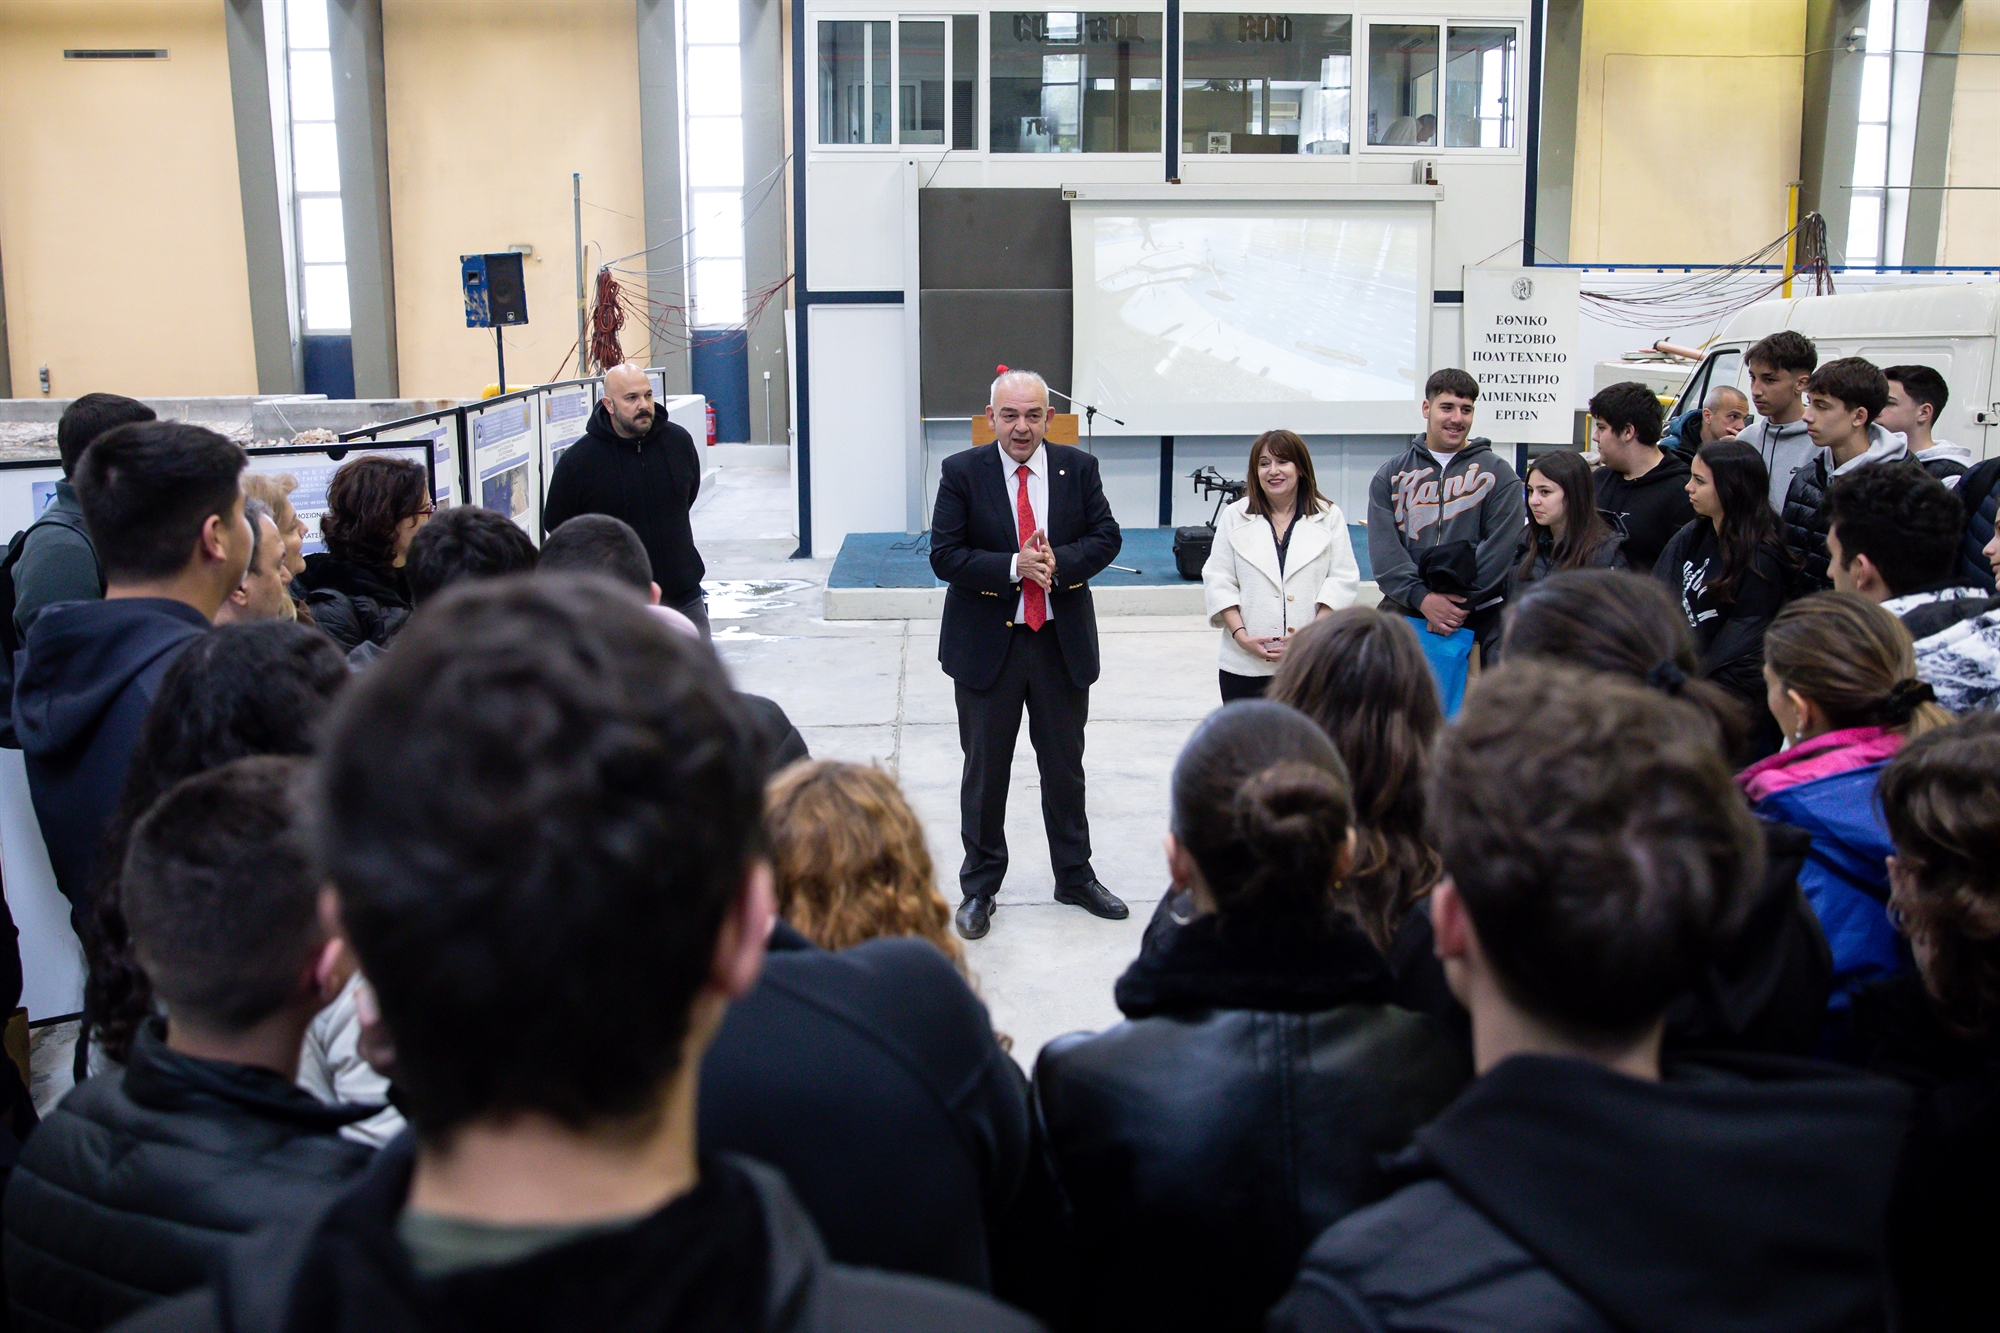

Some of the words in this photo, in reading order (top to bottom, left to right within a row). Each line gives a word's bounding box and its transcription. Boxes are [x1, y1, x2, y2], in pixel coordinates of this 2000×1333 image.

[1013, 13, 1145, 43] COROL
[1496, 315, 1547, 326] ΕΘΝΙΚΟ
[1485, 333, 1556, 344] ΜΕΤΣΟΒΙΟ
[1472, 351, 1567, 363] ΠΟΛΥΤΕΧΝΕΙΟ
[1478, 373, 1560, 385] ΕΡΓΑΣΤΗΡΙΟ
[1478, 391, 1557, 403] ΛΙΜΕΝΙΚΩΝ
[1495, 410, 1539, 420] ΕΡΓΩΝ
[1391, 463, 1496, 532] Kani
